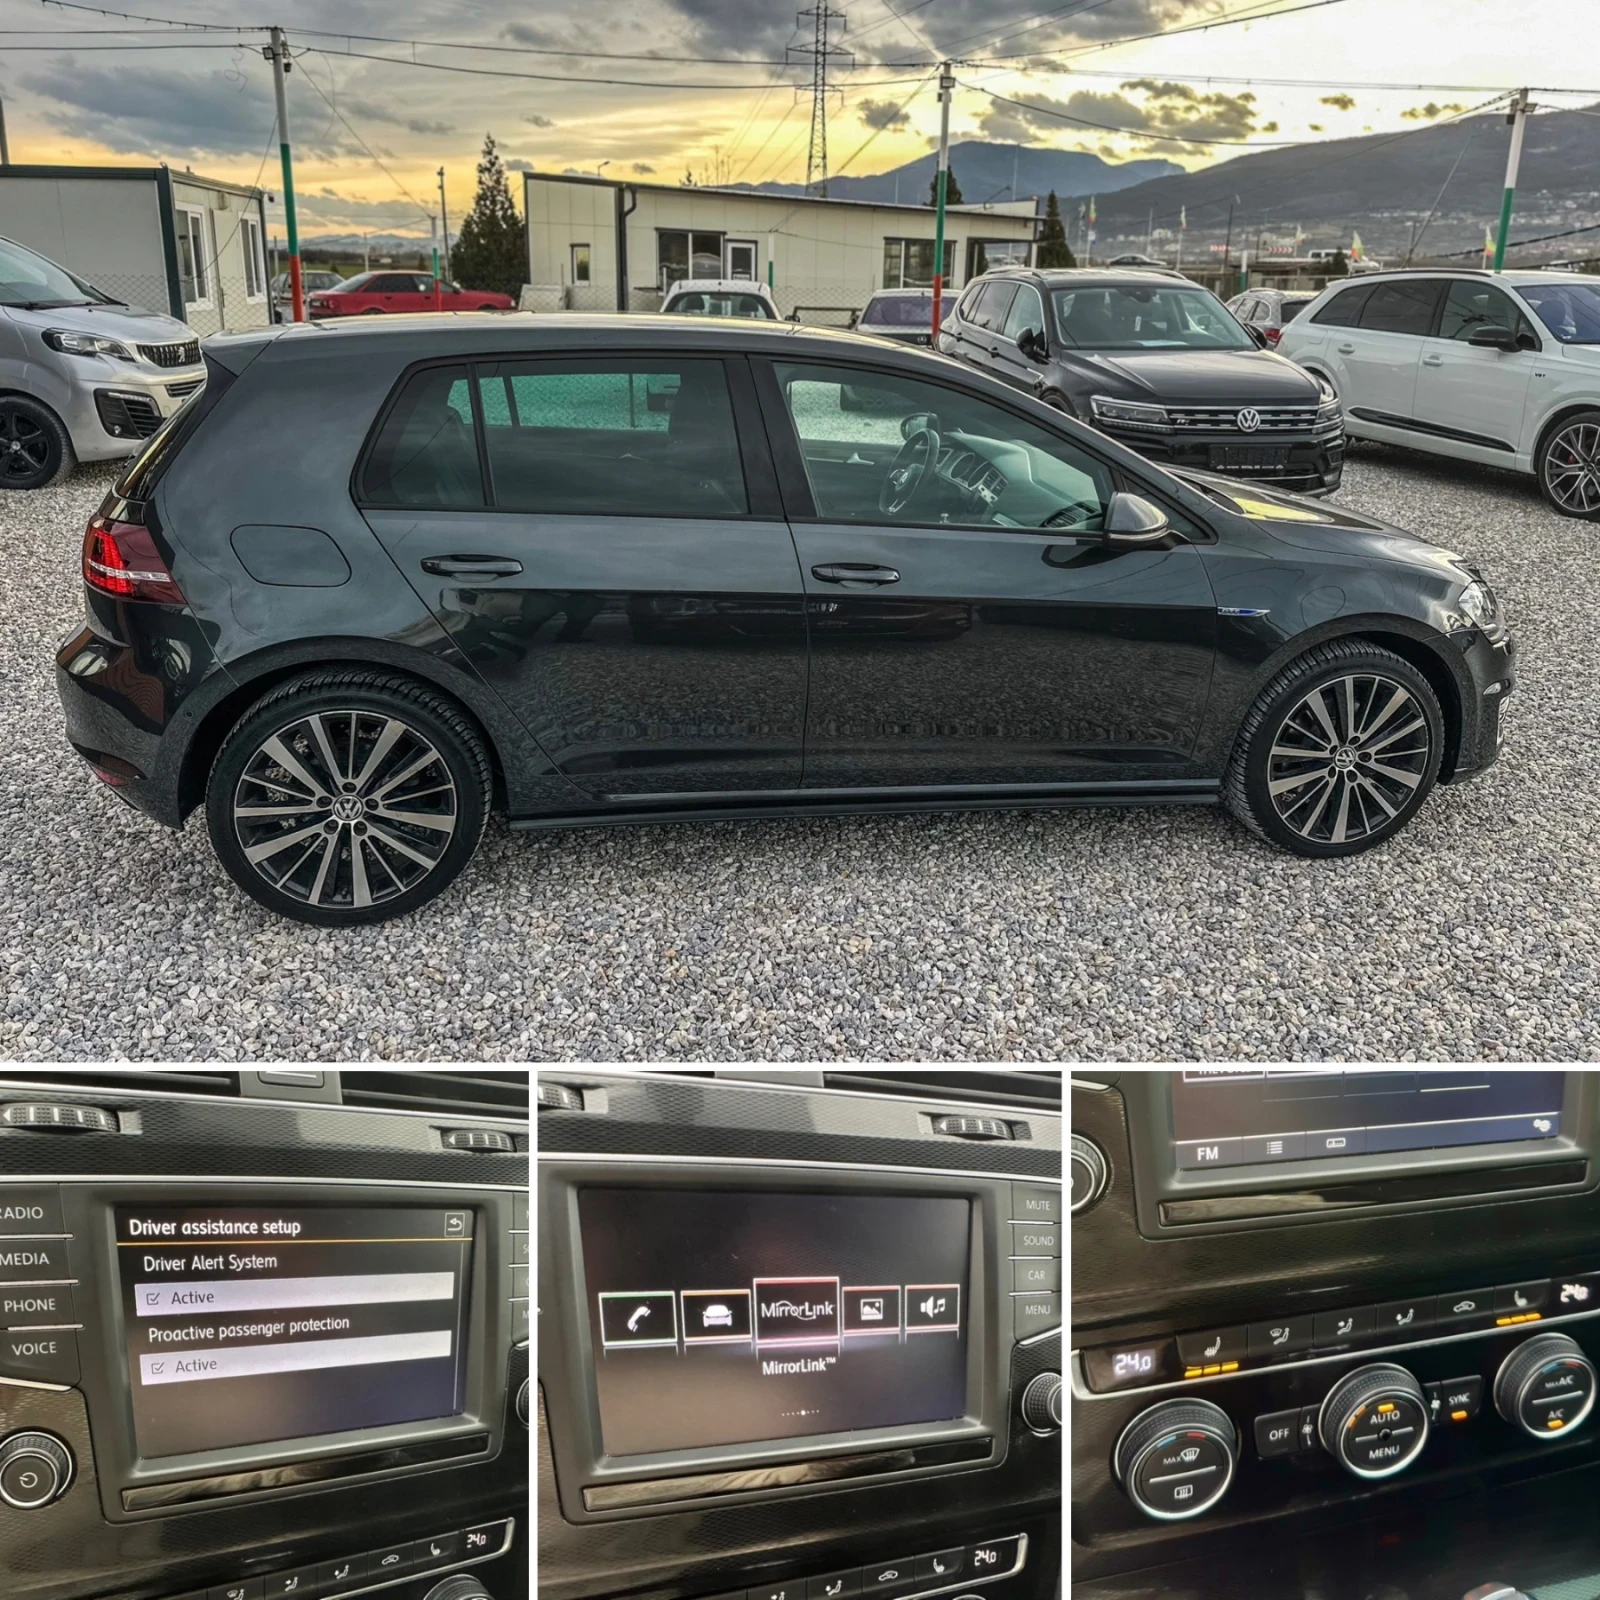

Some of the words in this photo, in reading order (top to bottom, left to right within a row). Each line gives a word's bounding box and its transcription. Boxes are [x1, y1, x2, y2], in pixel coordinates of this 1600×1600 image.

[1197, 1146, 1218, 1161] FM
[1026, 1200, 1051, 1210] MUTE
[0, 1206, 44, 1219] ADIO
[129, 1219, 176, 1235] Driver
[181, 1219, 258, 1235] assistance
[262, 1219, 301, 1237] setup
[1023, 1235, 1054, 1246] SOUND
[0, 1252, 50, 1265] MEDIA
[143, 1256, 186, 1272] Driver
[191, 1255, 224, 1271] Alert
[228, 1254, 278, 1271] System
[1028, 1270, 1046, 1280] CAR
[171, 1291, 215, 1305] Active
[4, 1299, 57, 1312] PHONE
[1025, 1305, 1051, 1316] MENU
[149, 1326, 214, 1343] Proactive
[219, 1321, 285, 1341] passenger
[289, 1317, 350, 1335] protection
[12, 1342, 57, 1356] VOICE
[175, 1358, 217, 1374] Active
[1448, 1392, 1471, 1406] SYNC
[1370, 1410, 1400, 1425] AUTO
[1548, 1408, 1564, 1419] A/C
[1269, 1427, 1290, 1441] OFF
[1369, 1445, 1400, 1459] MENU
[1163, 1456, 1182, 1465] MAX
